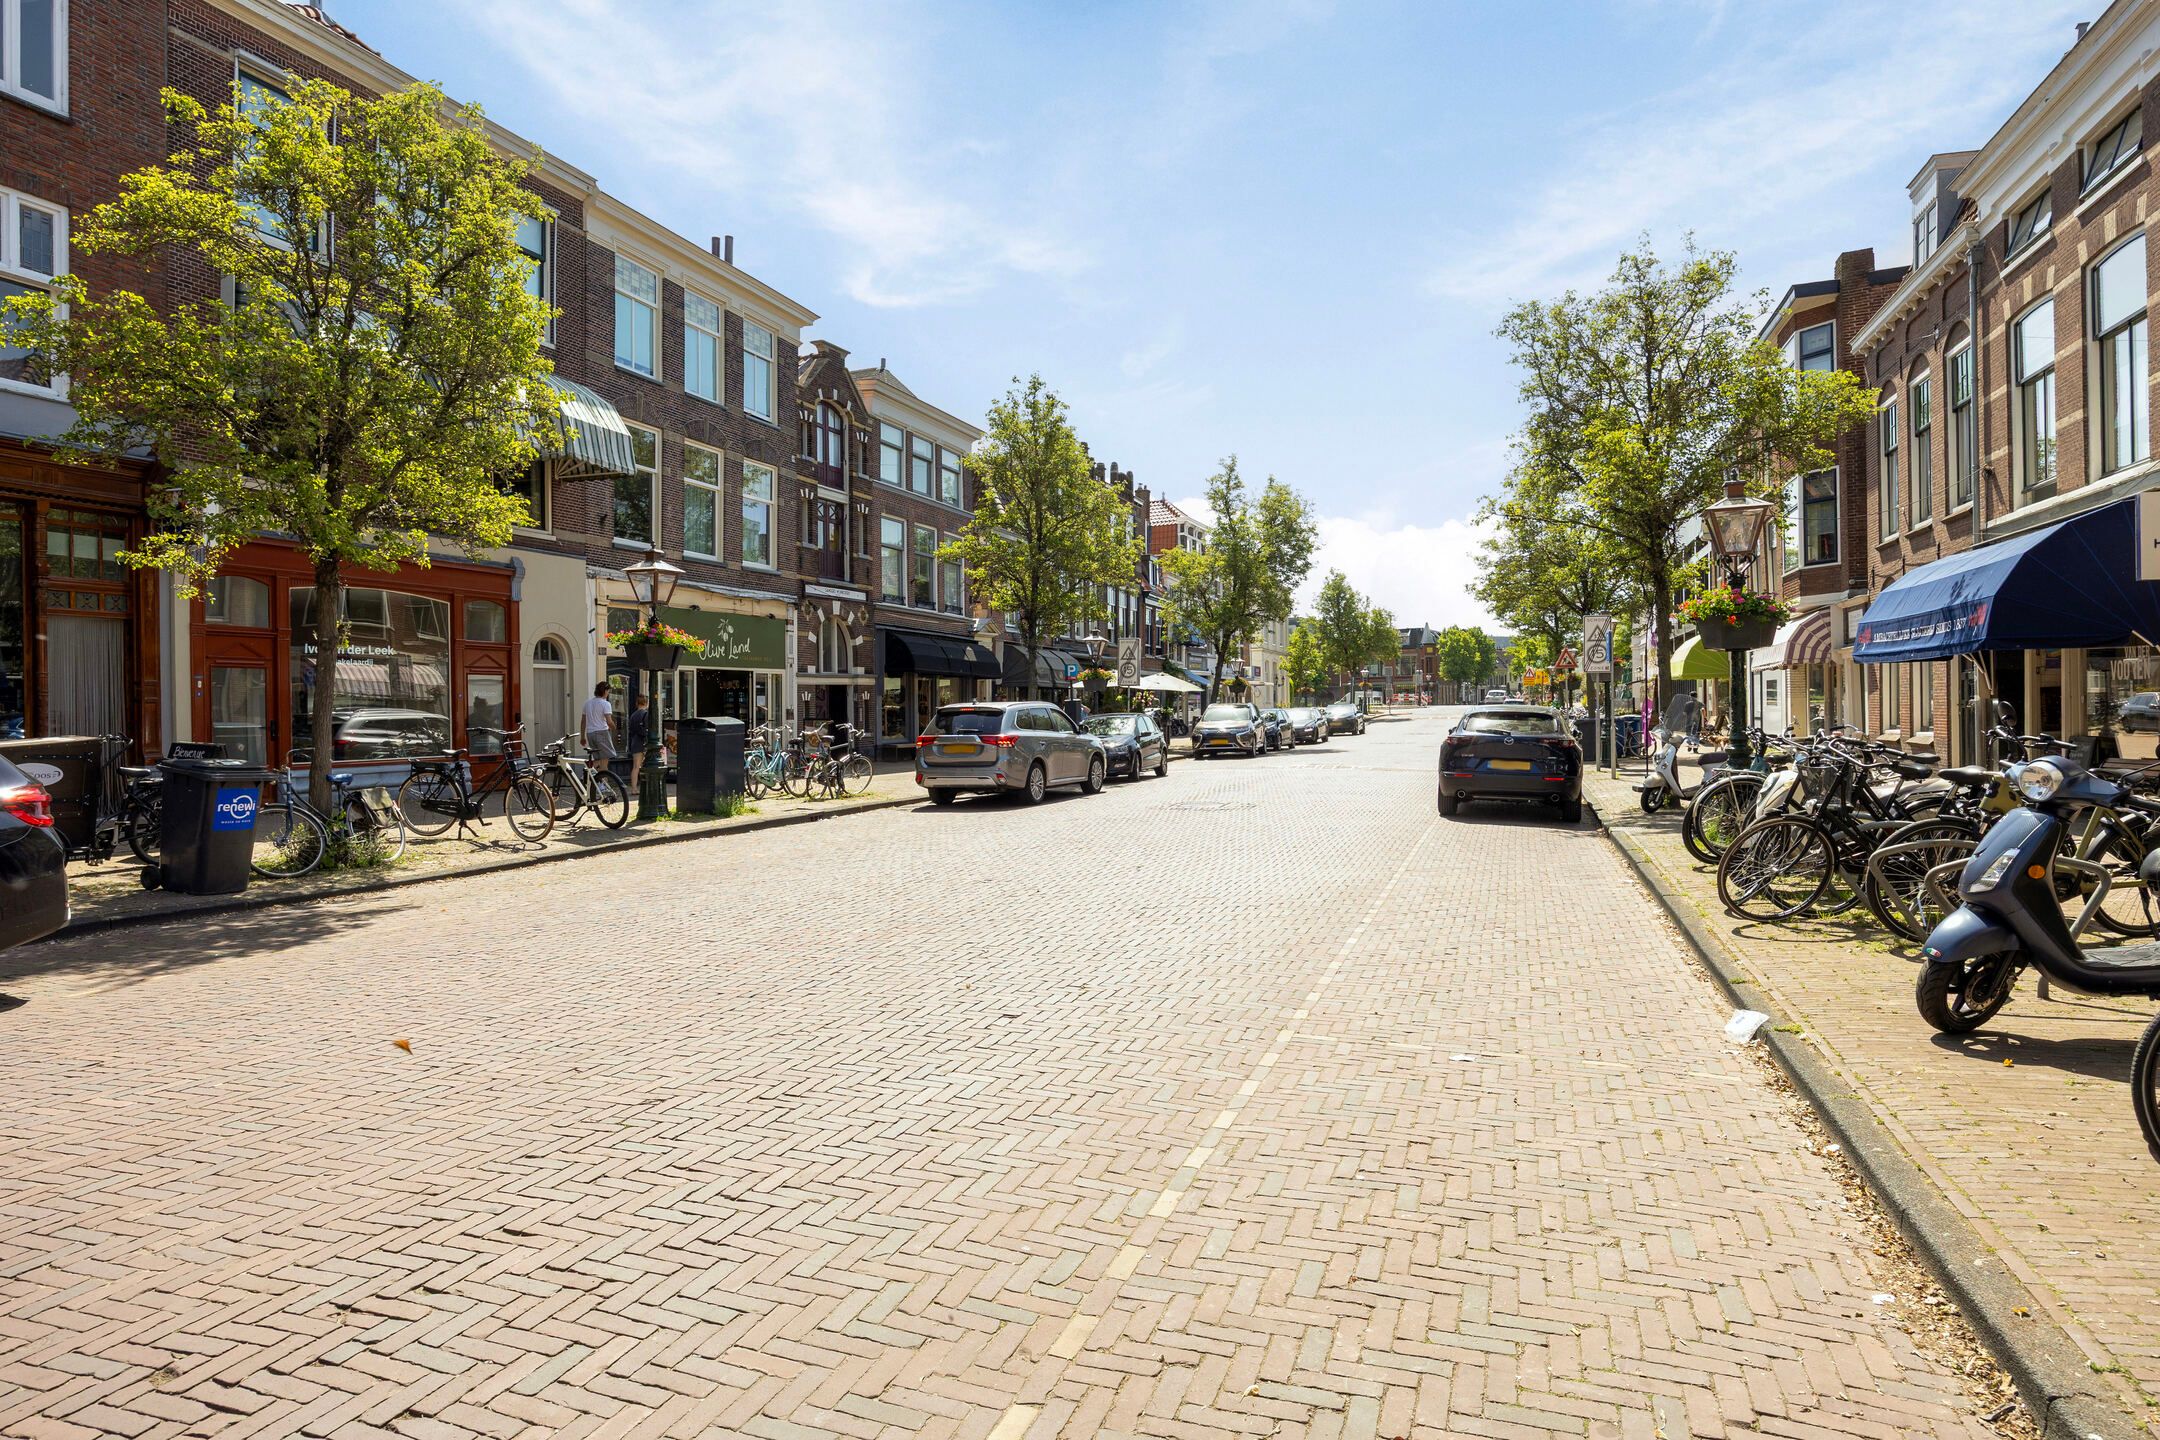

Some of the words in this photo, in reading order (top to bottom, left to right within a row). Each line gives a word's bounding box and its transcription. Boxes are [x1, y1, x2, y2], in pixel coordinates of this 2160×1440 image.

[347, 644, 366, 655] der
[368, 645, 394, 655] Leek
[728, 637, 751, 660] Land
[2137, 645, 2150, 658] DER
[1067, 665, 1076, 677] P
[217, 800, 256, 812] renewi
